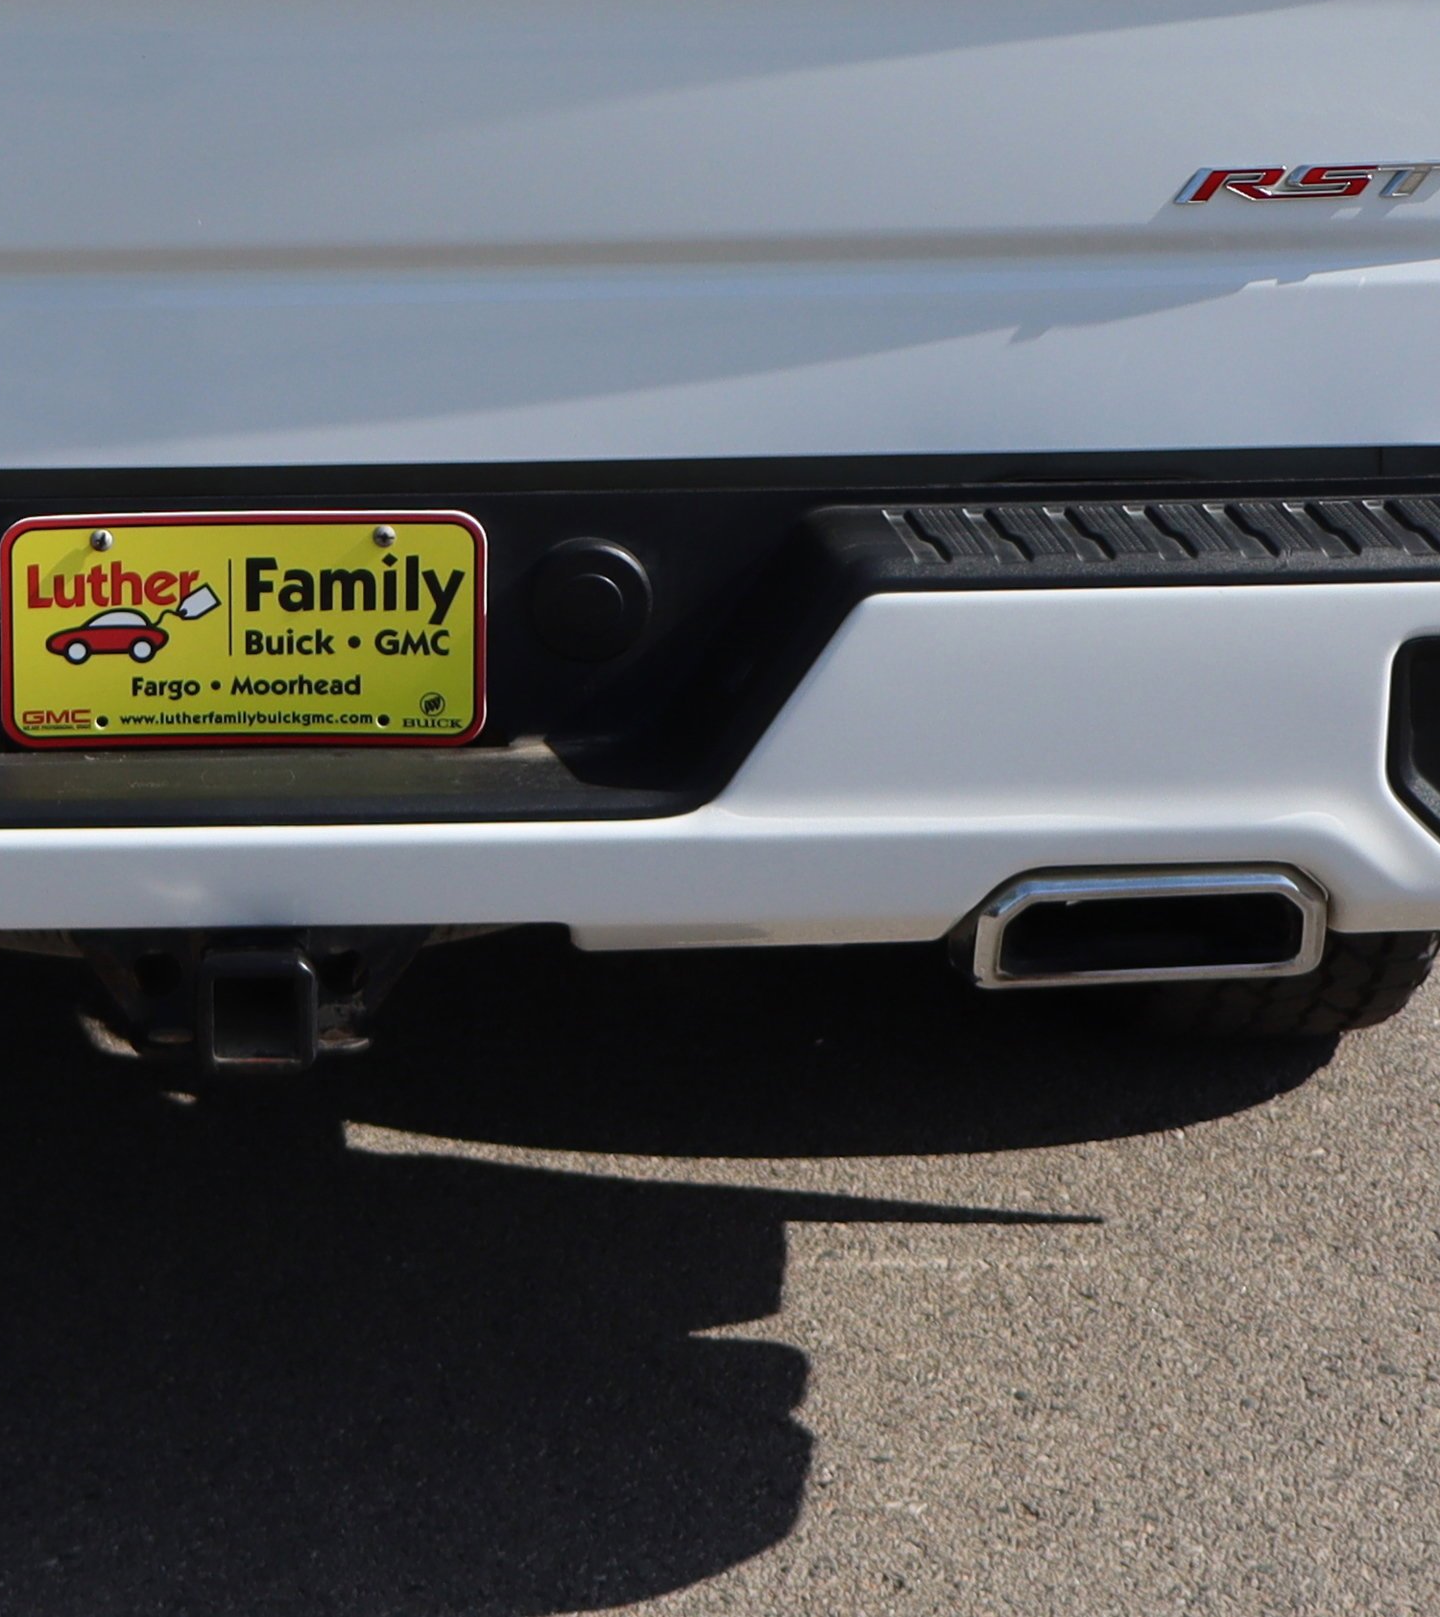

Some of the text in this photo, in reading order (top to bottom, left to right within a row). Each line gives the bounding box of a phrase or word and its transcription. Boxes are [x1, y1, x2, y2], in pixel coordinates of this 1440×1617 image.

[27, 553, 466, 626] Luther Family
[245, 628, 450, 656] Buick GMC
[132, 674, 361, 701] Fargo Moorhead
[22, 709, 91, 725] GMC
[119, 711, 373, 726] www.lutherfamilybuickgmc.com
[402, 718, 463, 729] BUICK
